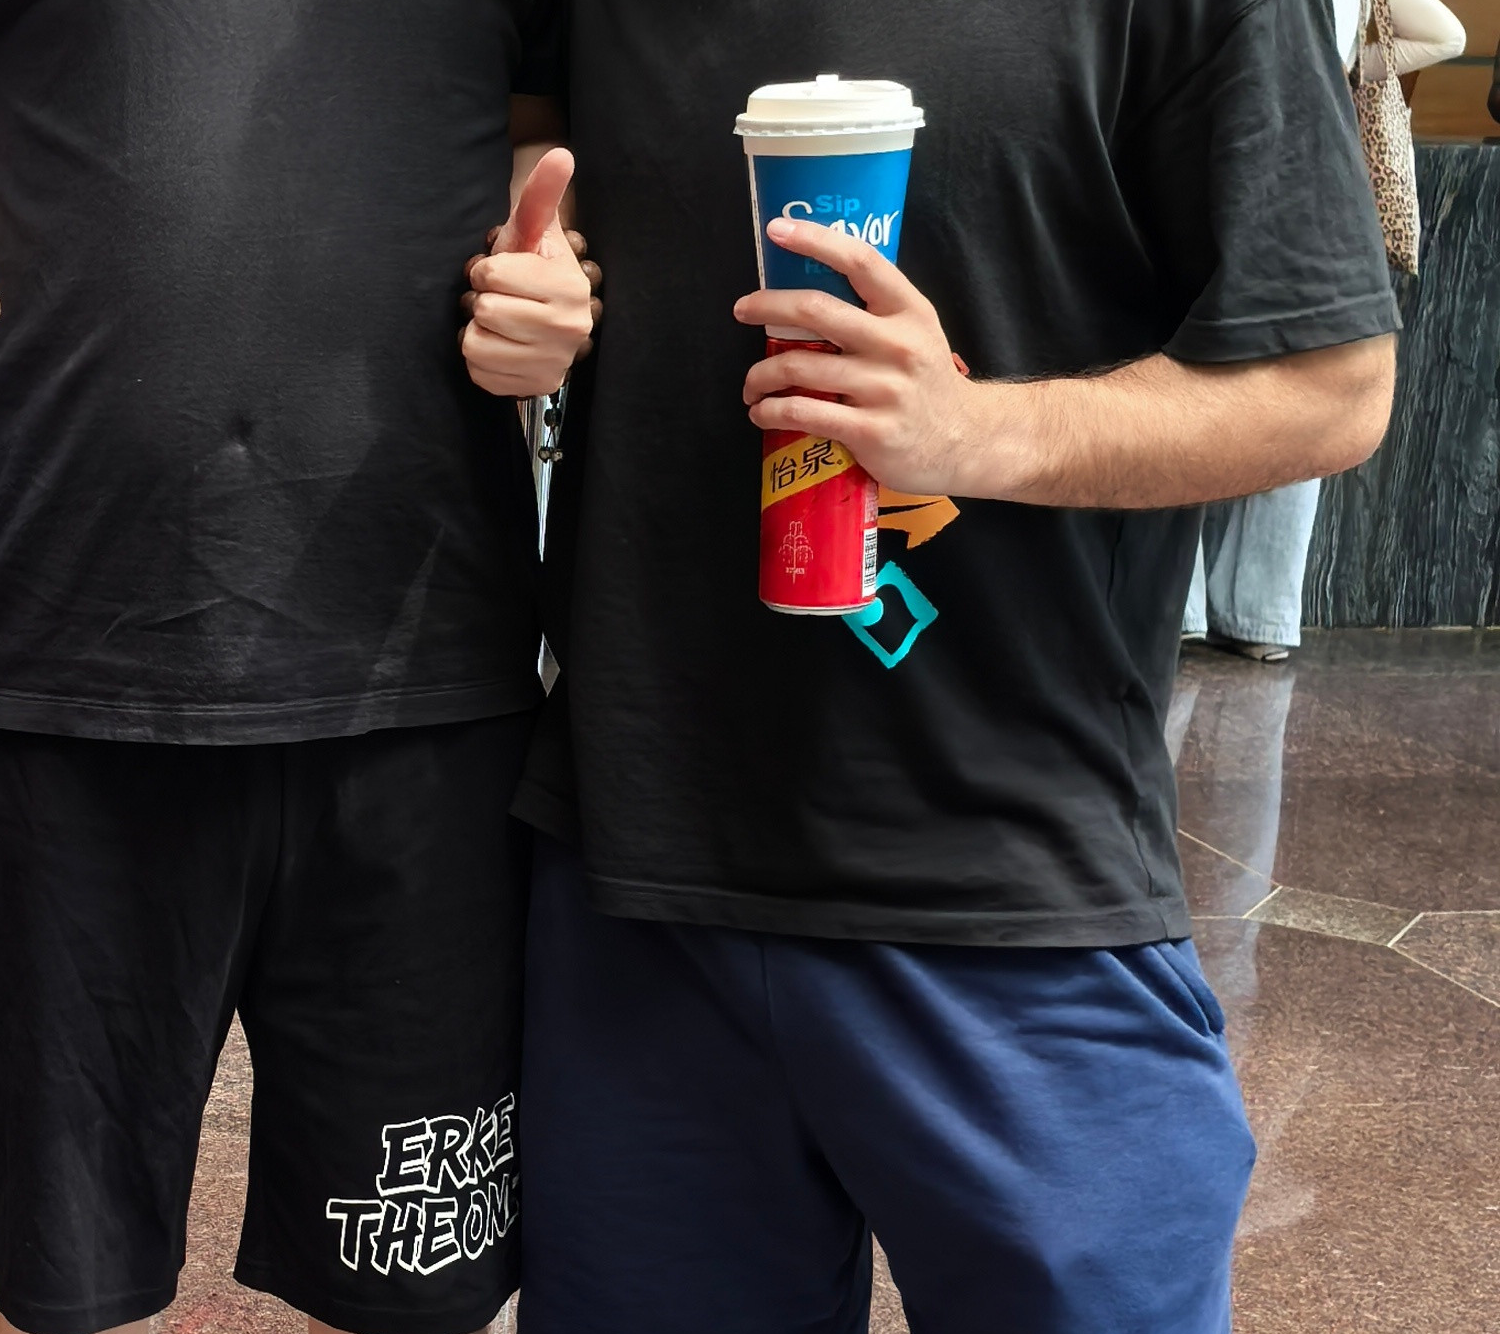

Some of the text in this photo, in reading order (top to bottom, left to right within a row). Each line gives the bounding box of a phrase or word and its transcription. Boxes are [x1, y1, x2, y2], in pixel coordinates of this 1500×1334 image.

[815, 194, 860, 217] Sip
[771, 440, 835, 493] 怡泉
[376, 1092, 514, 1197] ERKE
